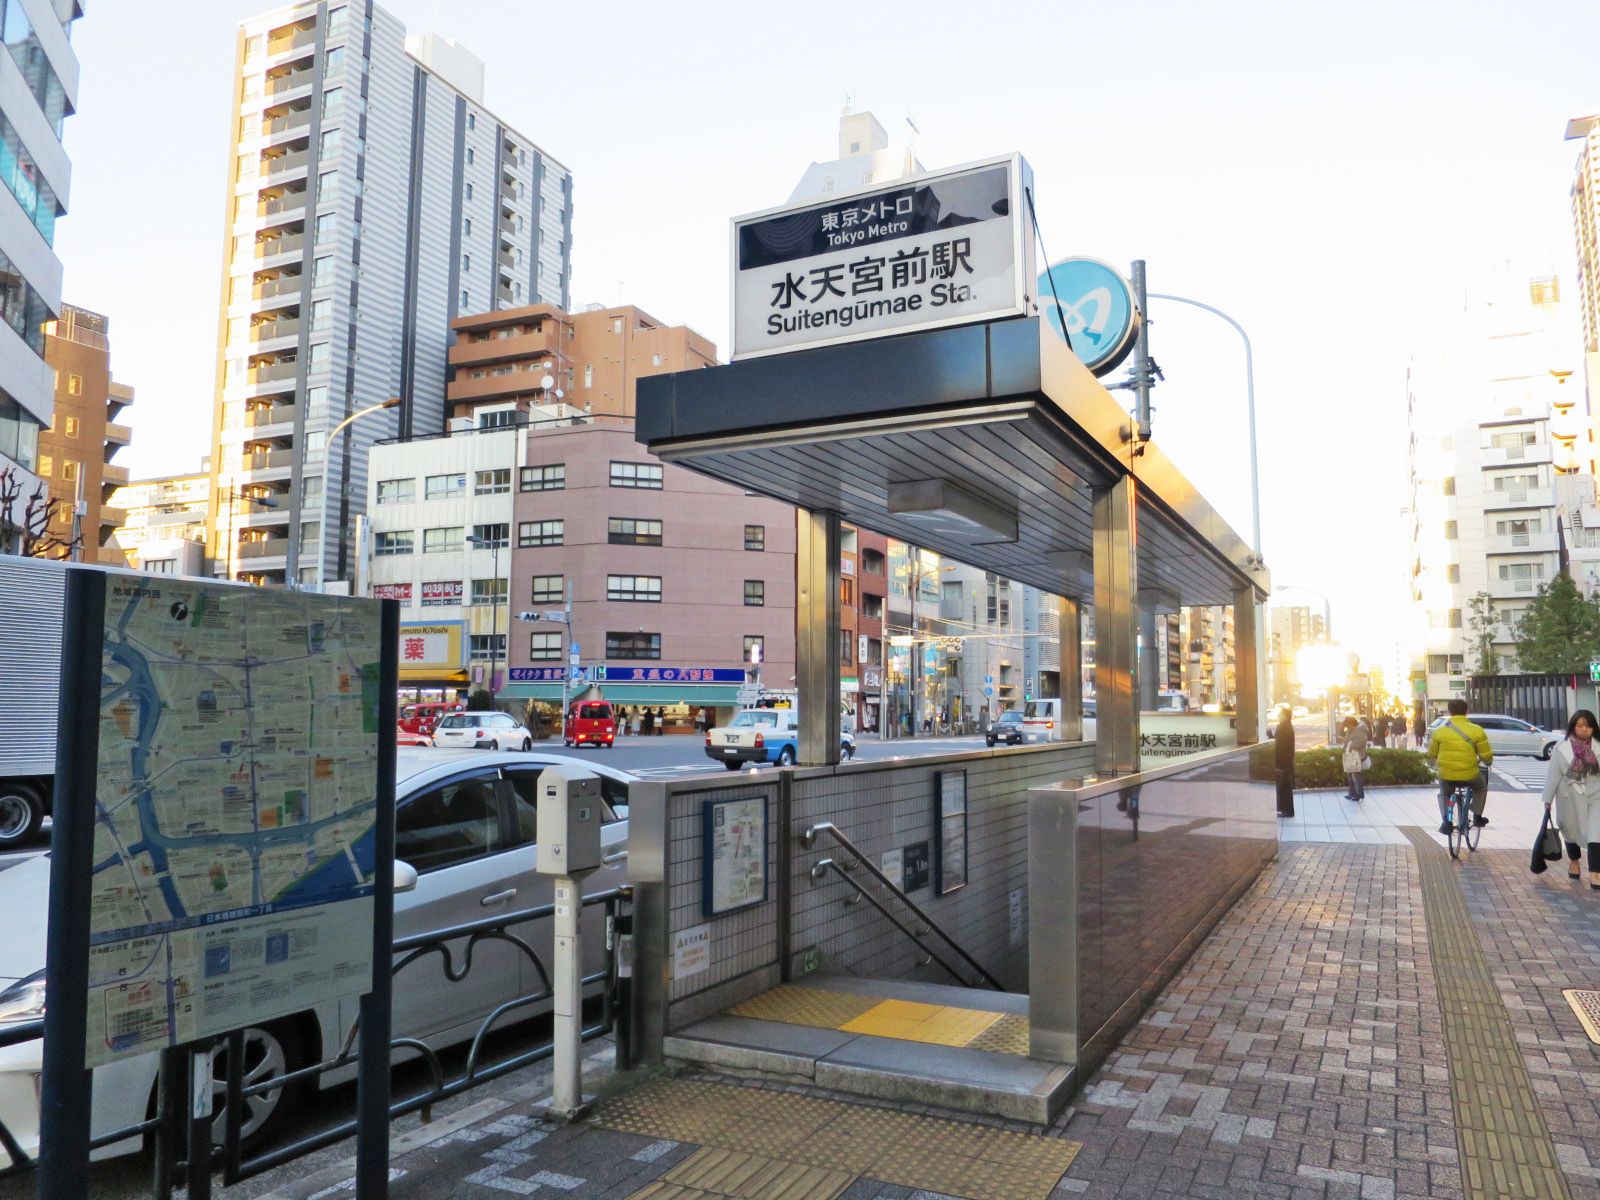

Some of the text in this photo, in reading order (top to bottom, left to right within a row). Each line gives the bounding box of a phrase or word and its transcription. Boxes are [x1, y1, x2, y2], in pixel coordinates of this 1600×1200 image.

[821, 195, 912, 232] 東京メトロ
[827, 220, 908, 246] Tokyo Metro
[770, 237, 973, 310] 水天宮前駅
[766, 284, 977, 336] Suitengūmae Sta.
[404, 637, 425, 660] 薬
[1140, 733, 1217, 748] 水天宮前駅
